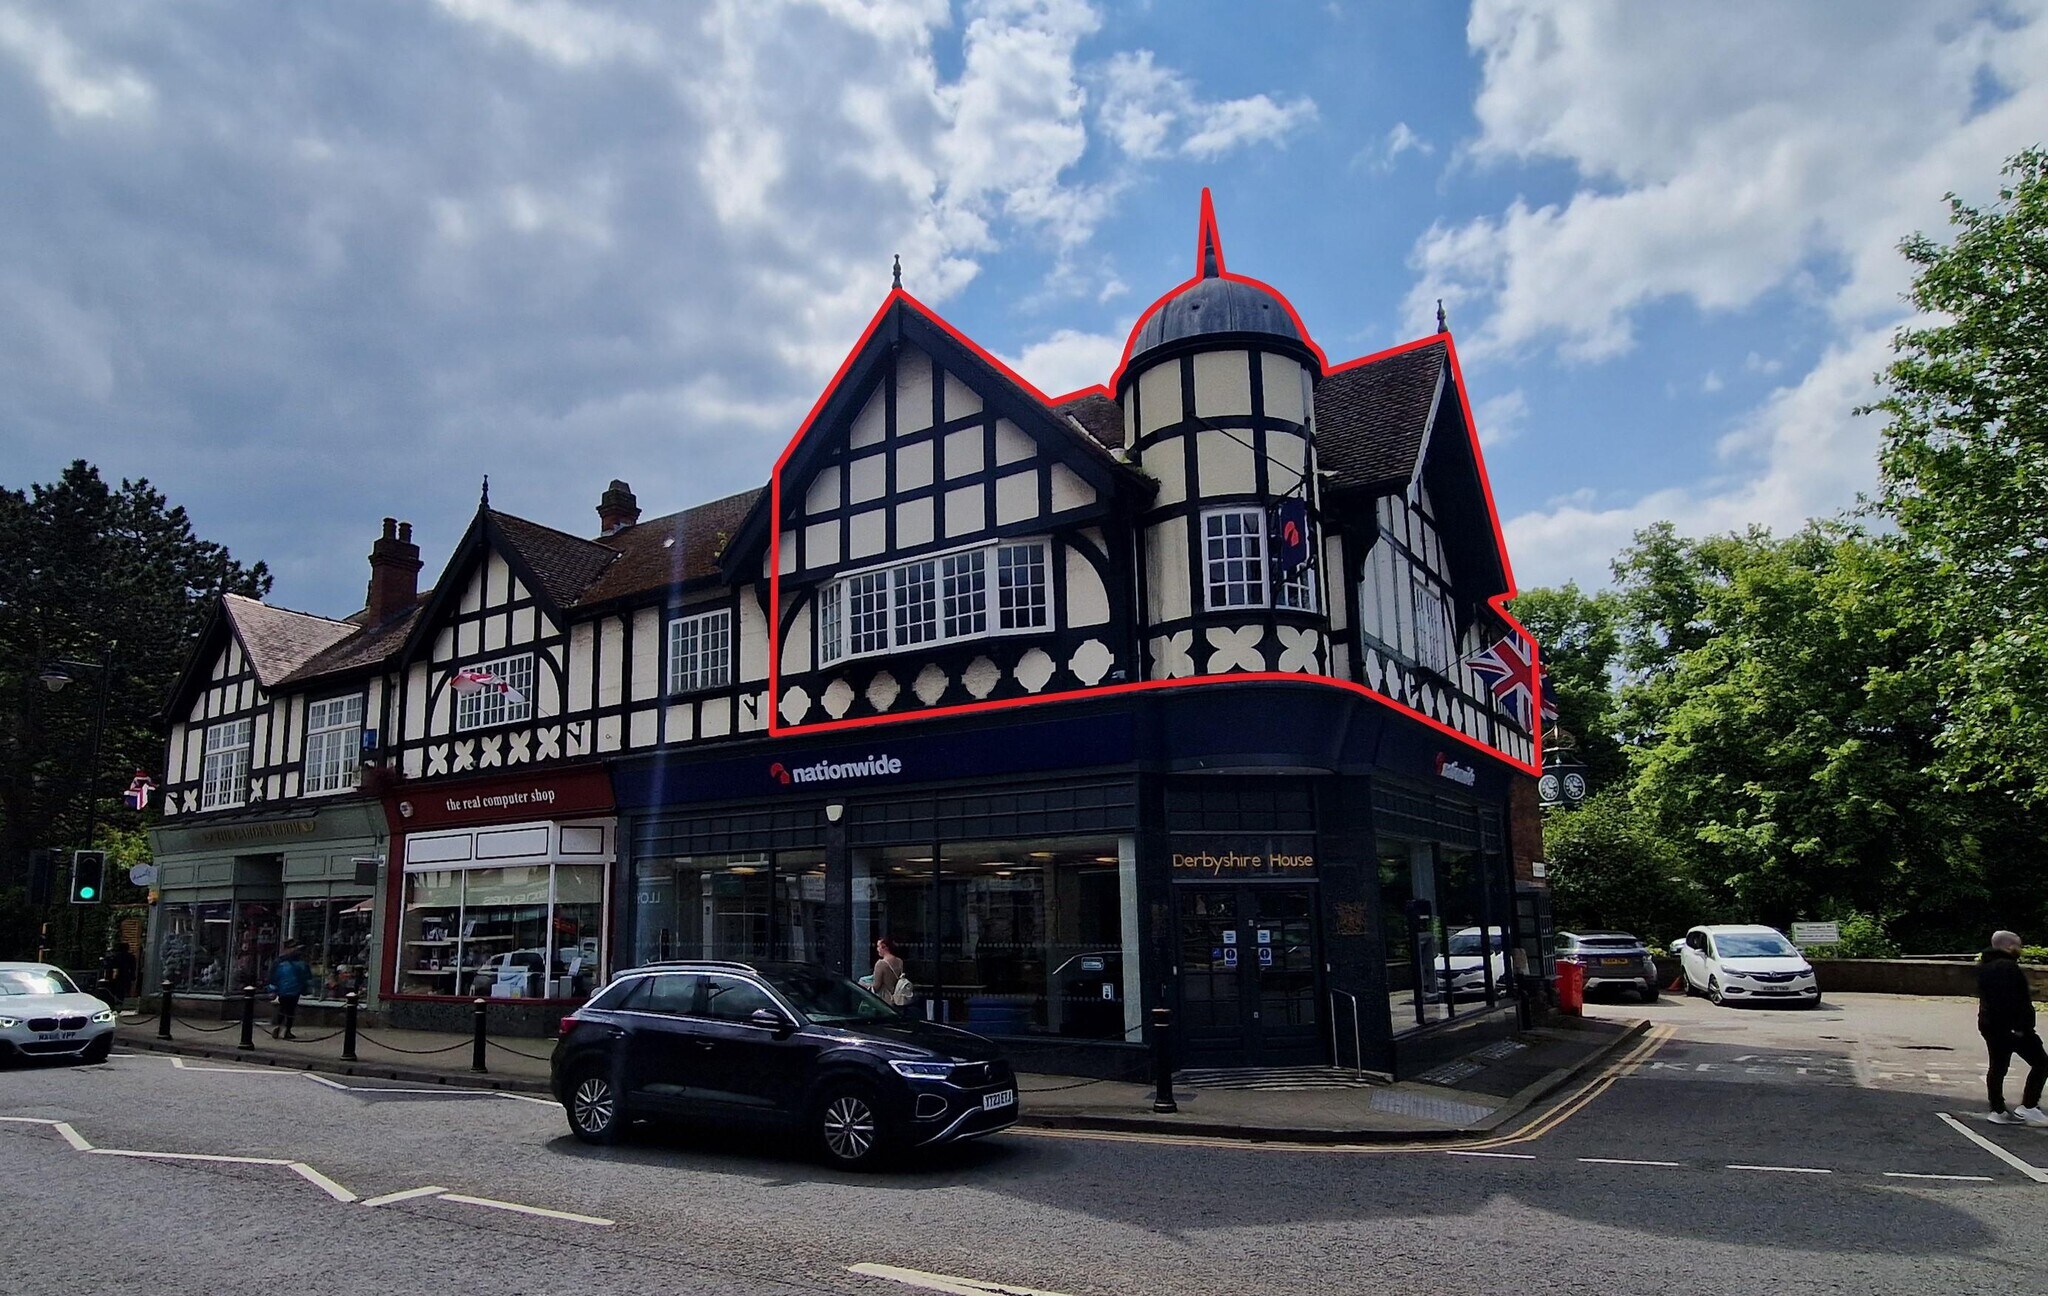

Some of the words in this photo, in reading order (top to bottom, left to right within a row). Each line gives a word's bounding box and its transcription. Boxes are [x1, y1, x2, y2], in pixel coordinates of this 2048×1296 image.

[792, 753, 902, 783] nationwide
[446, 797, 461, 811] the
[463, 795, 481, 810] real
[483, 791, 528, 809] computer
[530, 788, 555, 804] shop
[1172, 850, 1262, 876] Derbyshire
[1269, 853, 1314, 867] House
